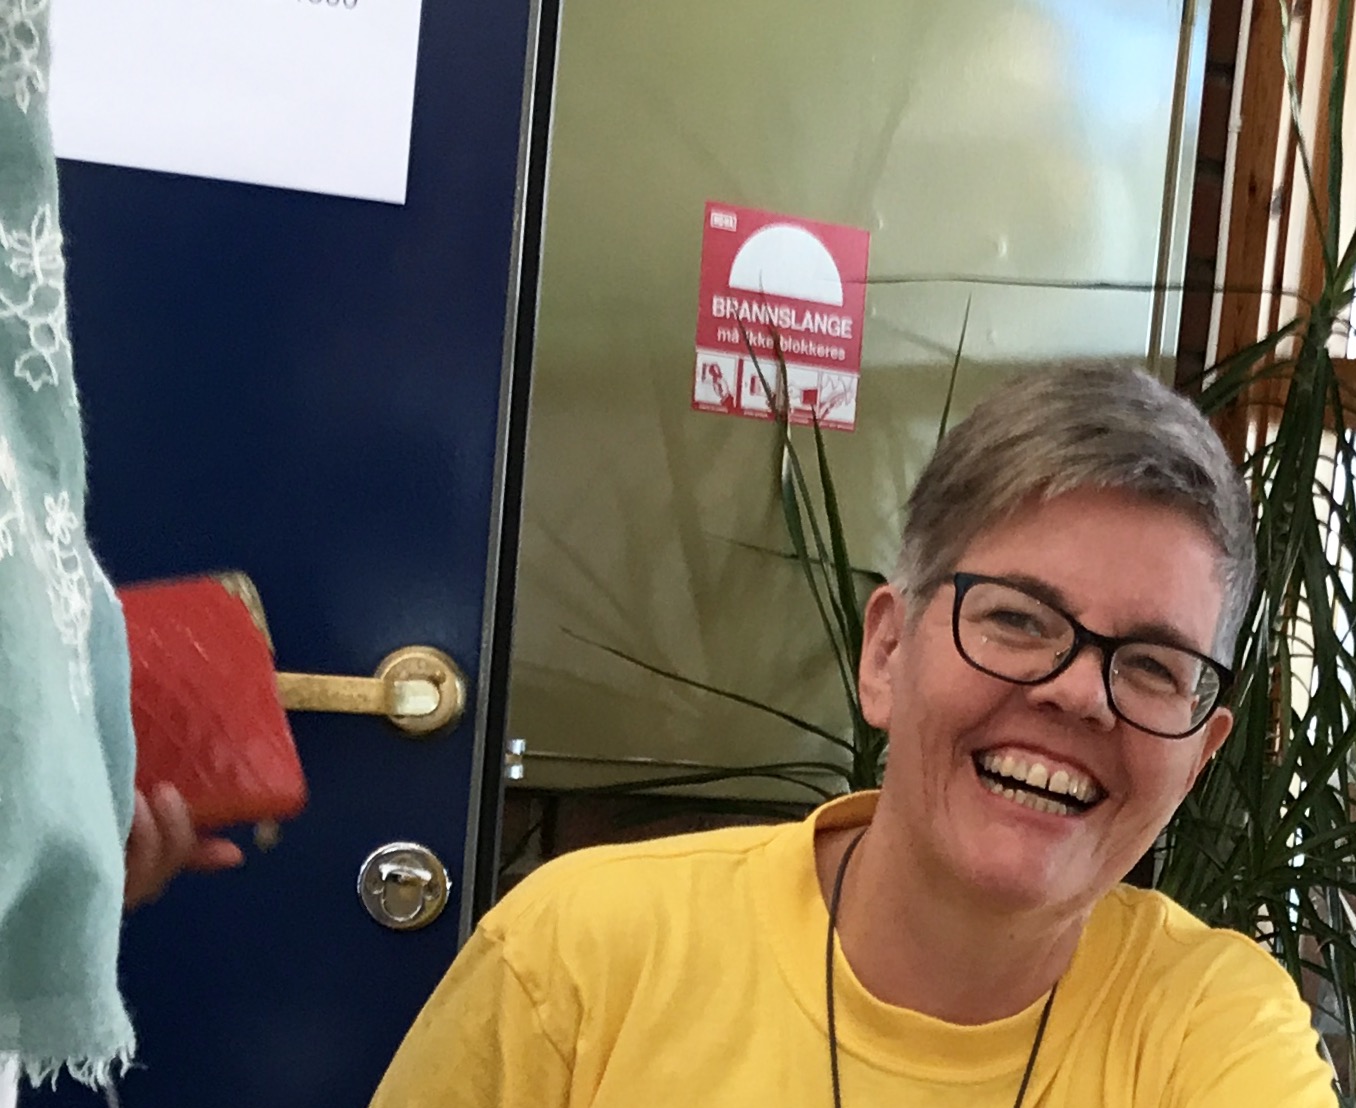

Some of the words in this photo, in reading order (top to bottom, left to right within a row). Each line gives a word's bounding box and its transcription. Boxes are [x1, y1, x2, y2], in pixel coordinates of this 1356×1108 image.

[712, 294, 853, 340] BRANNSLANGE
[717, 326, 739, 345] må
[780, 335, 846, 361] blokkeres
